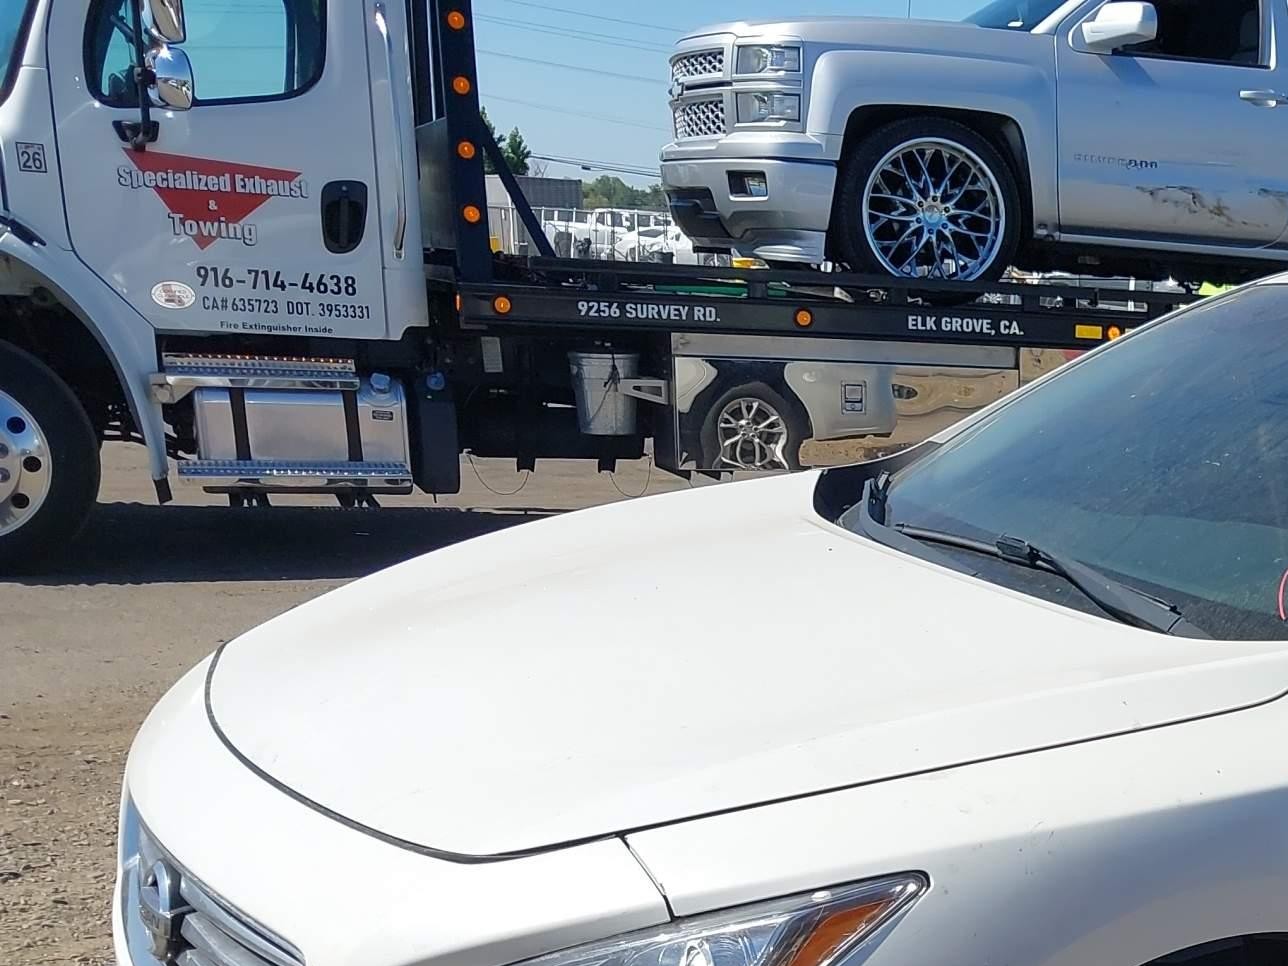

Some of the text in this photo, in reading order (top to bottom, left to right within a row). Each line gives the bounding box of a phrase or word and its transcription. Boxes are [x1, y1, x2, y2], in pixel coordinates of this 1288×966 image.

[21, 150, 43, 170] 26
[117, 166, 309, 198] Specialized Exhaust
[208, 199, 218, 211] &
[168, 212, 257, 246] Towing
[196, 265, 357, 297] 916-714-4638
[286, 300, 315, 317] DOT.
[318, 302, 371, 320] 3953331
[577, 301, 721, 322] 9256 SURVEY RD.
[220, 321, 334, 335] Fire Extinguisher Inside
[907, 315, 1024, 336] ELK GROVE, CA.
